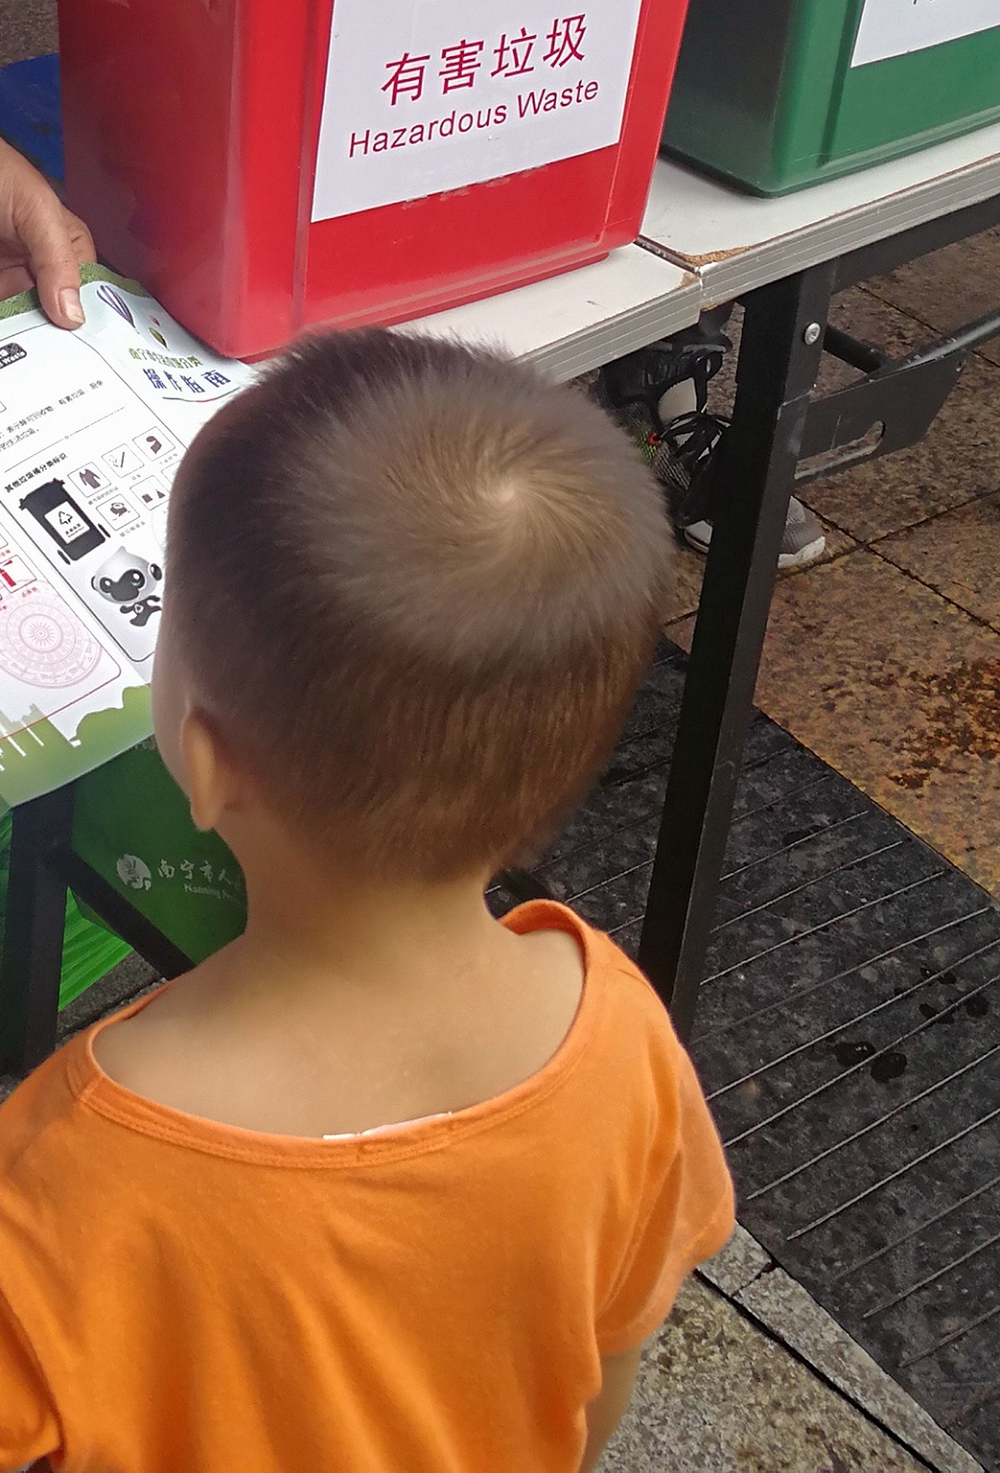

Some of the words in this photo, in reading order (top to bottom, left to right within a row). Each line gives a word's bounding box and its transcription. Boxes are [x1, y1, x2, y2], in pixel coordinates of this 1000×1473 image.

[381, 13, 587, 106] 有害垃圾
[349, 104, 507, 158] Hazardous
[518, 79, 599, 118] Waste
